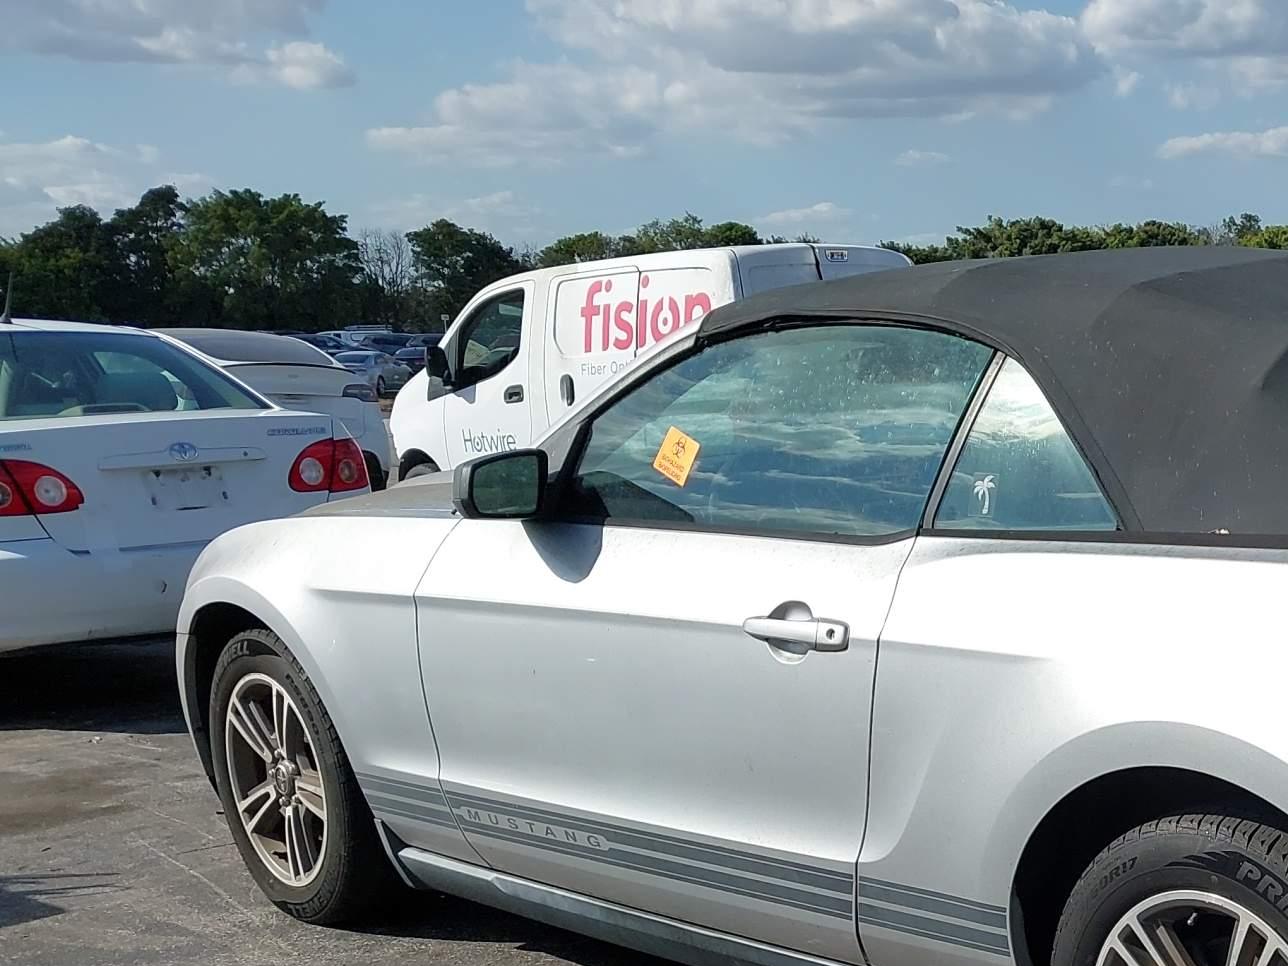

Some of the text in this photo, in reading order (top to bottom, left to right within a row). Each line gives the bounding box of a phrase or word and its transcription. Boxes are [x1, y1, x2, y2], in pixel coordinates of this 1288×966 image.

[580, 274, 712, 353] fision
[580, 361, 606, 376] Fiber
[461, 428, 516, 452] Hotwire
[466, 809, 602, 848] MUSTANG
